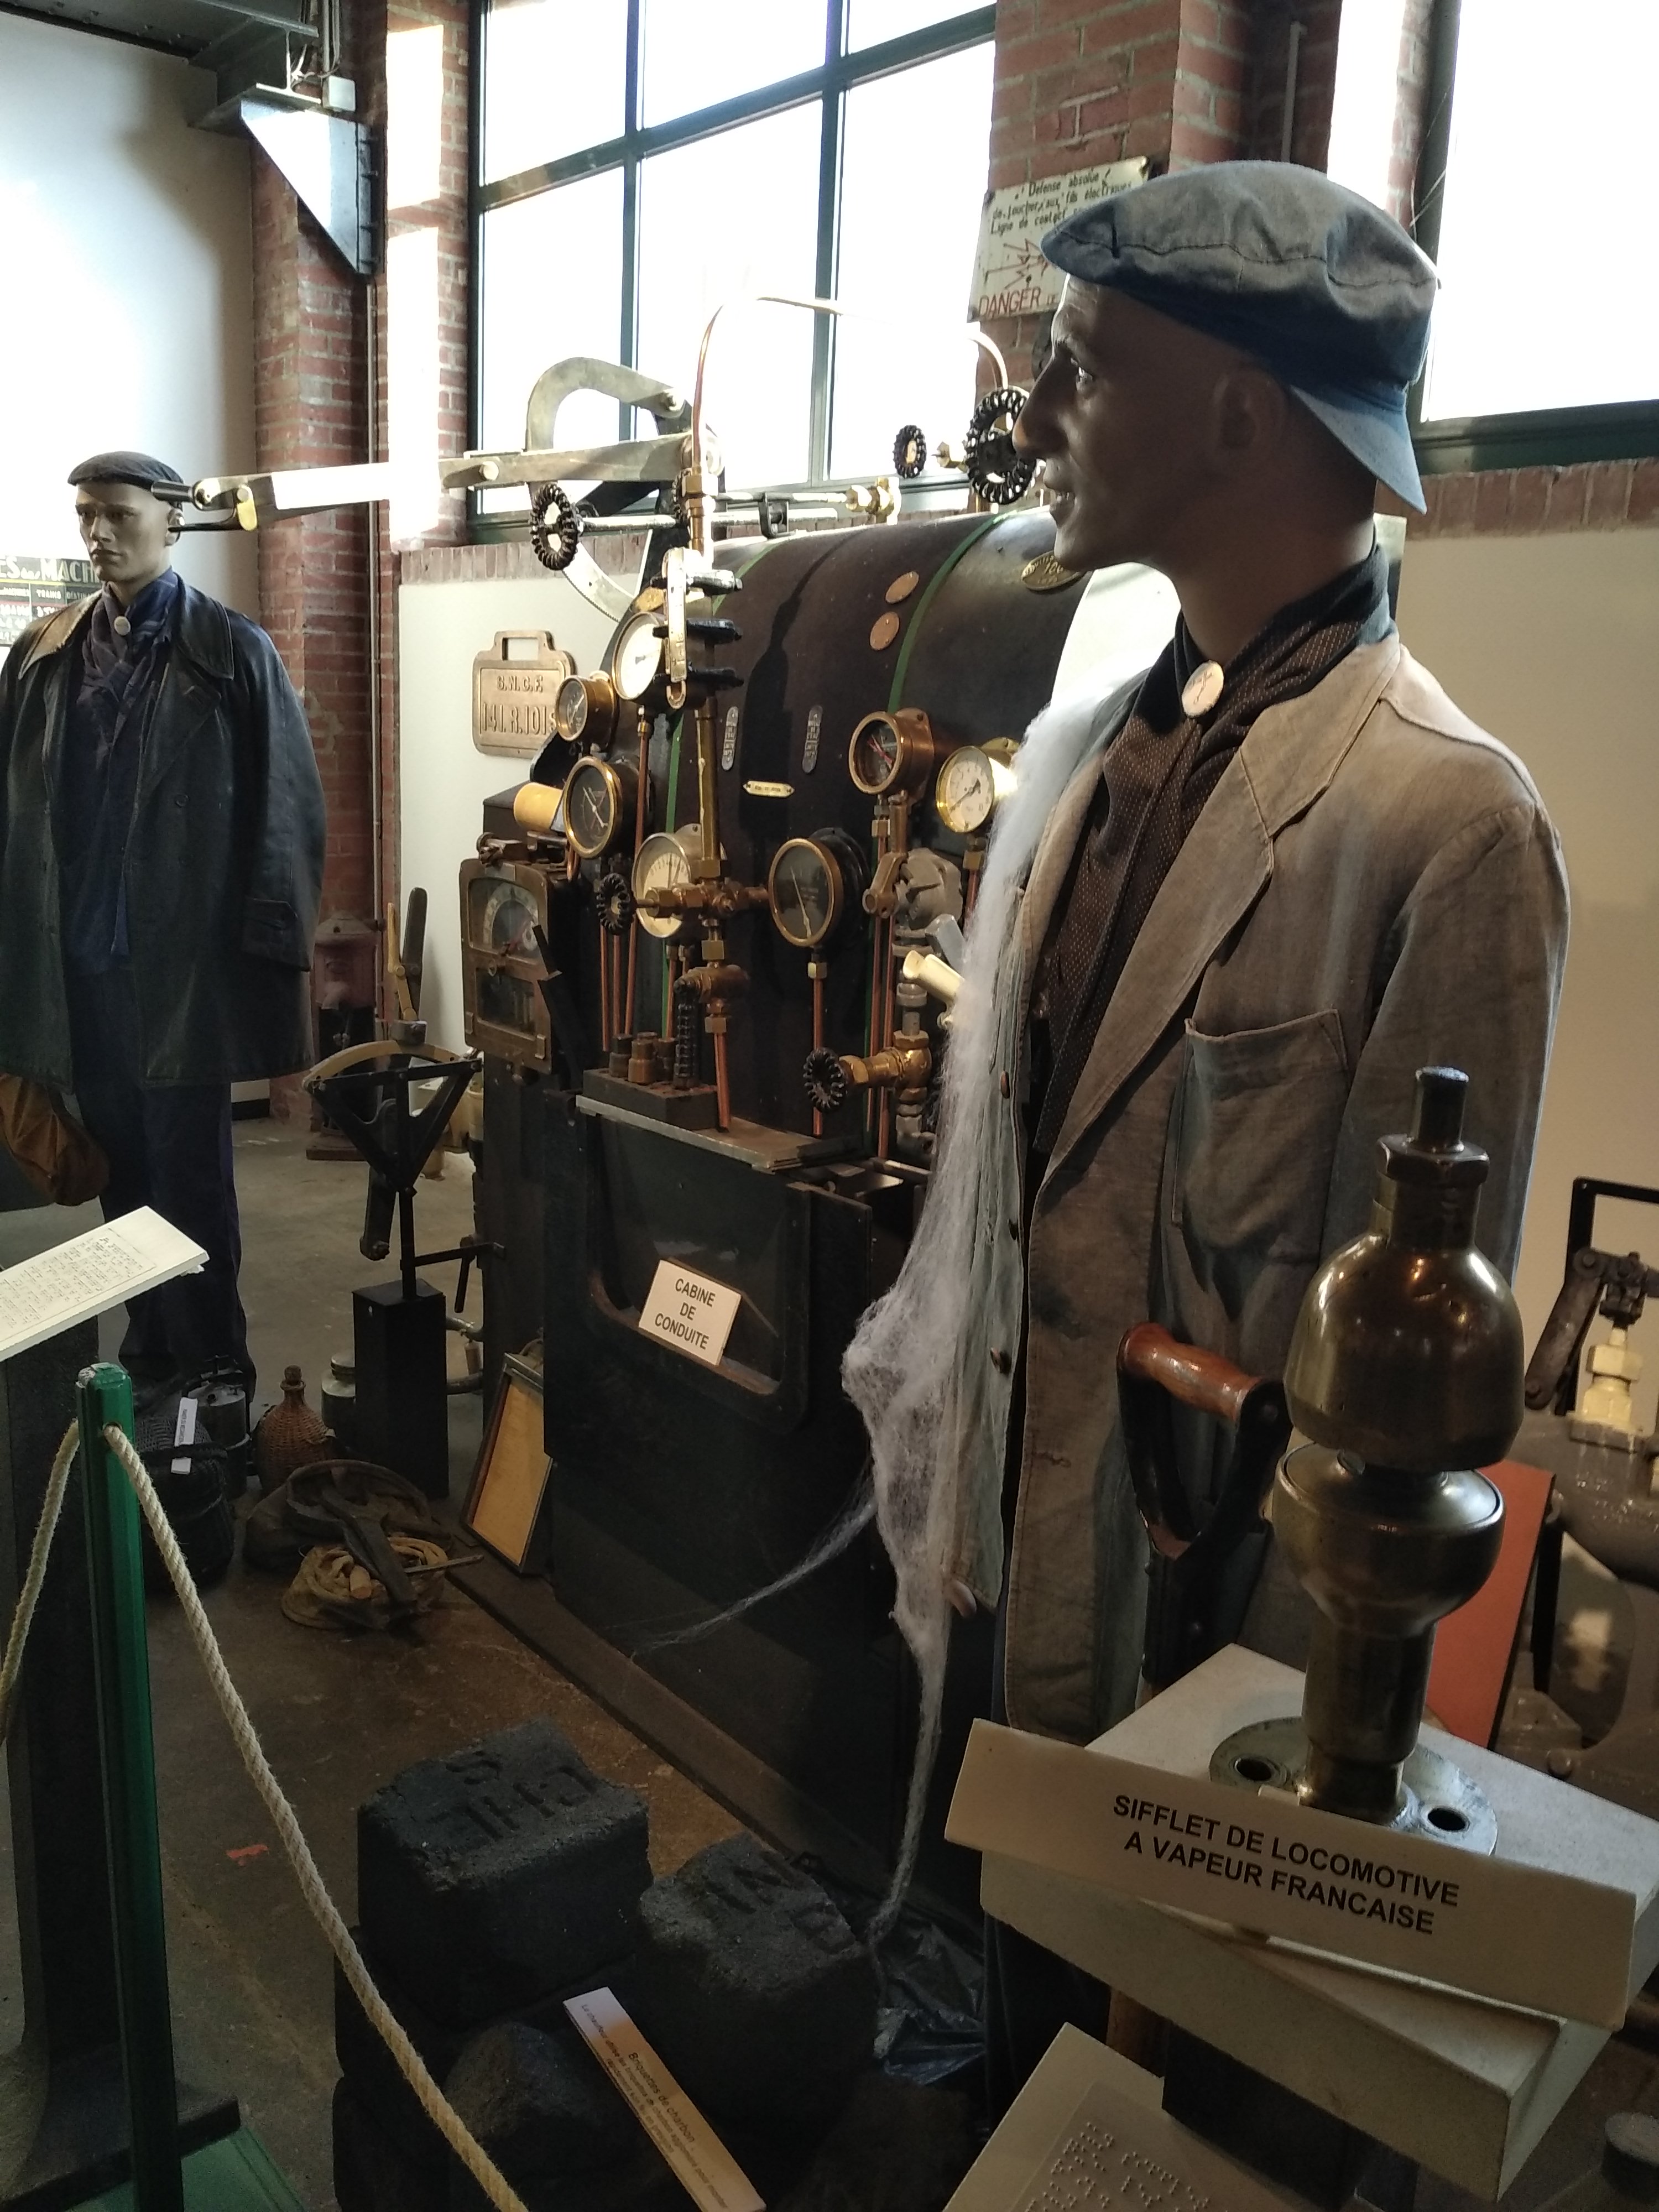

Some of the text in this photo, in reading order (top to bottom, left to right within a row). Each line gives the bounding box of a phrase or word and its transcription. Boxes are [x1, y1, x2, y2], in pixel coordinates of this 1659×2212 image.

[978, 286, 1041, 319] DANGER
[496, 675, 544, 692] S.N.C.F.
[675, 1278, 716, 1307] CABINE
[680, 1302, 697, 1321] DE
[655, 1313, 709, 1350] CONDUITE
[1113, 1794, 1460, 1907] SIFFLET DE LOCOMOTIVE
[1124, 1831, 1435, 1935] A VAPEUR FRANCAISE
[629, 2052, 695, 2142] Briquettes de charbon
